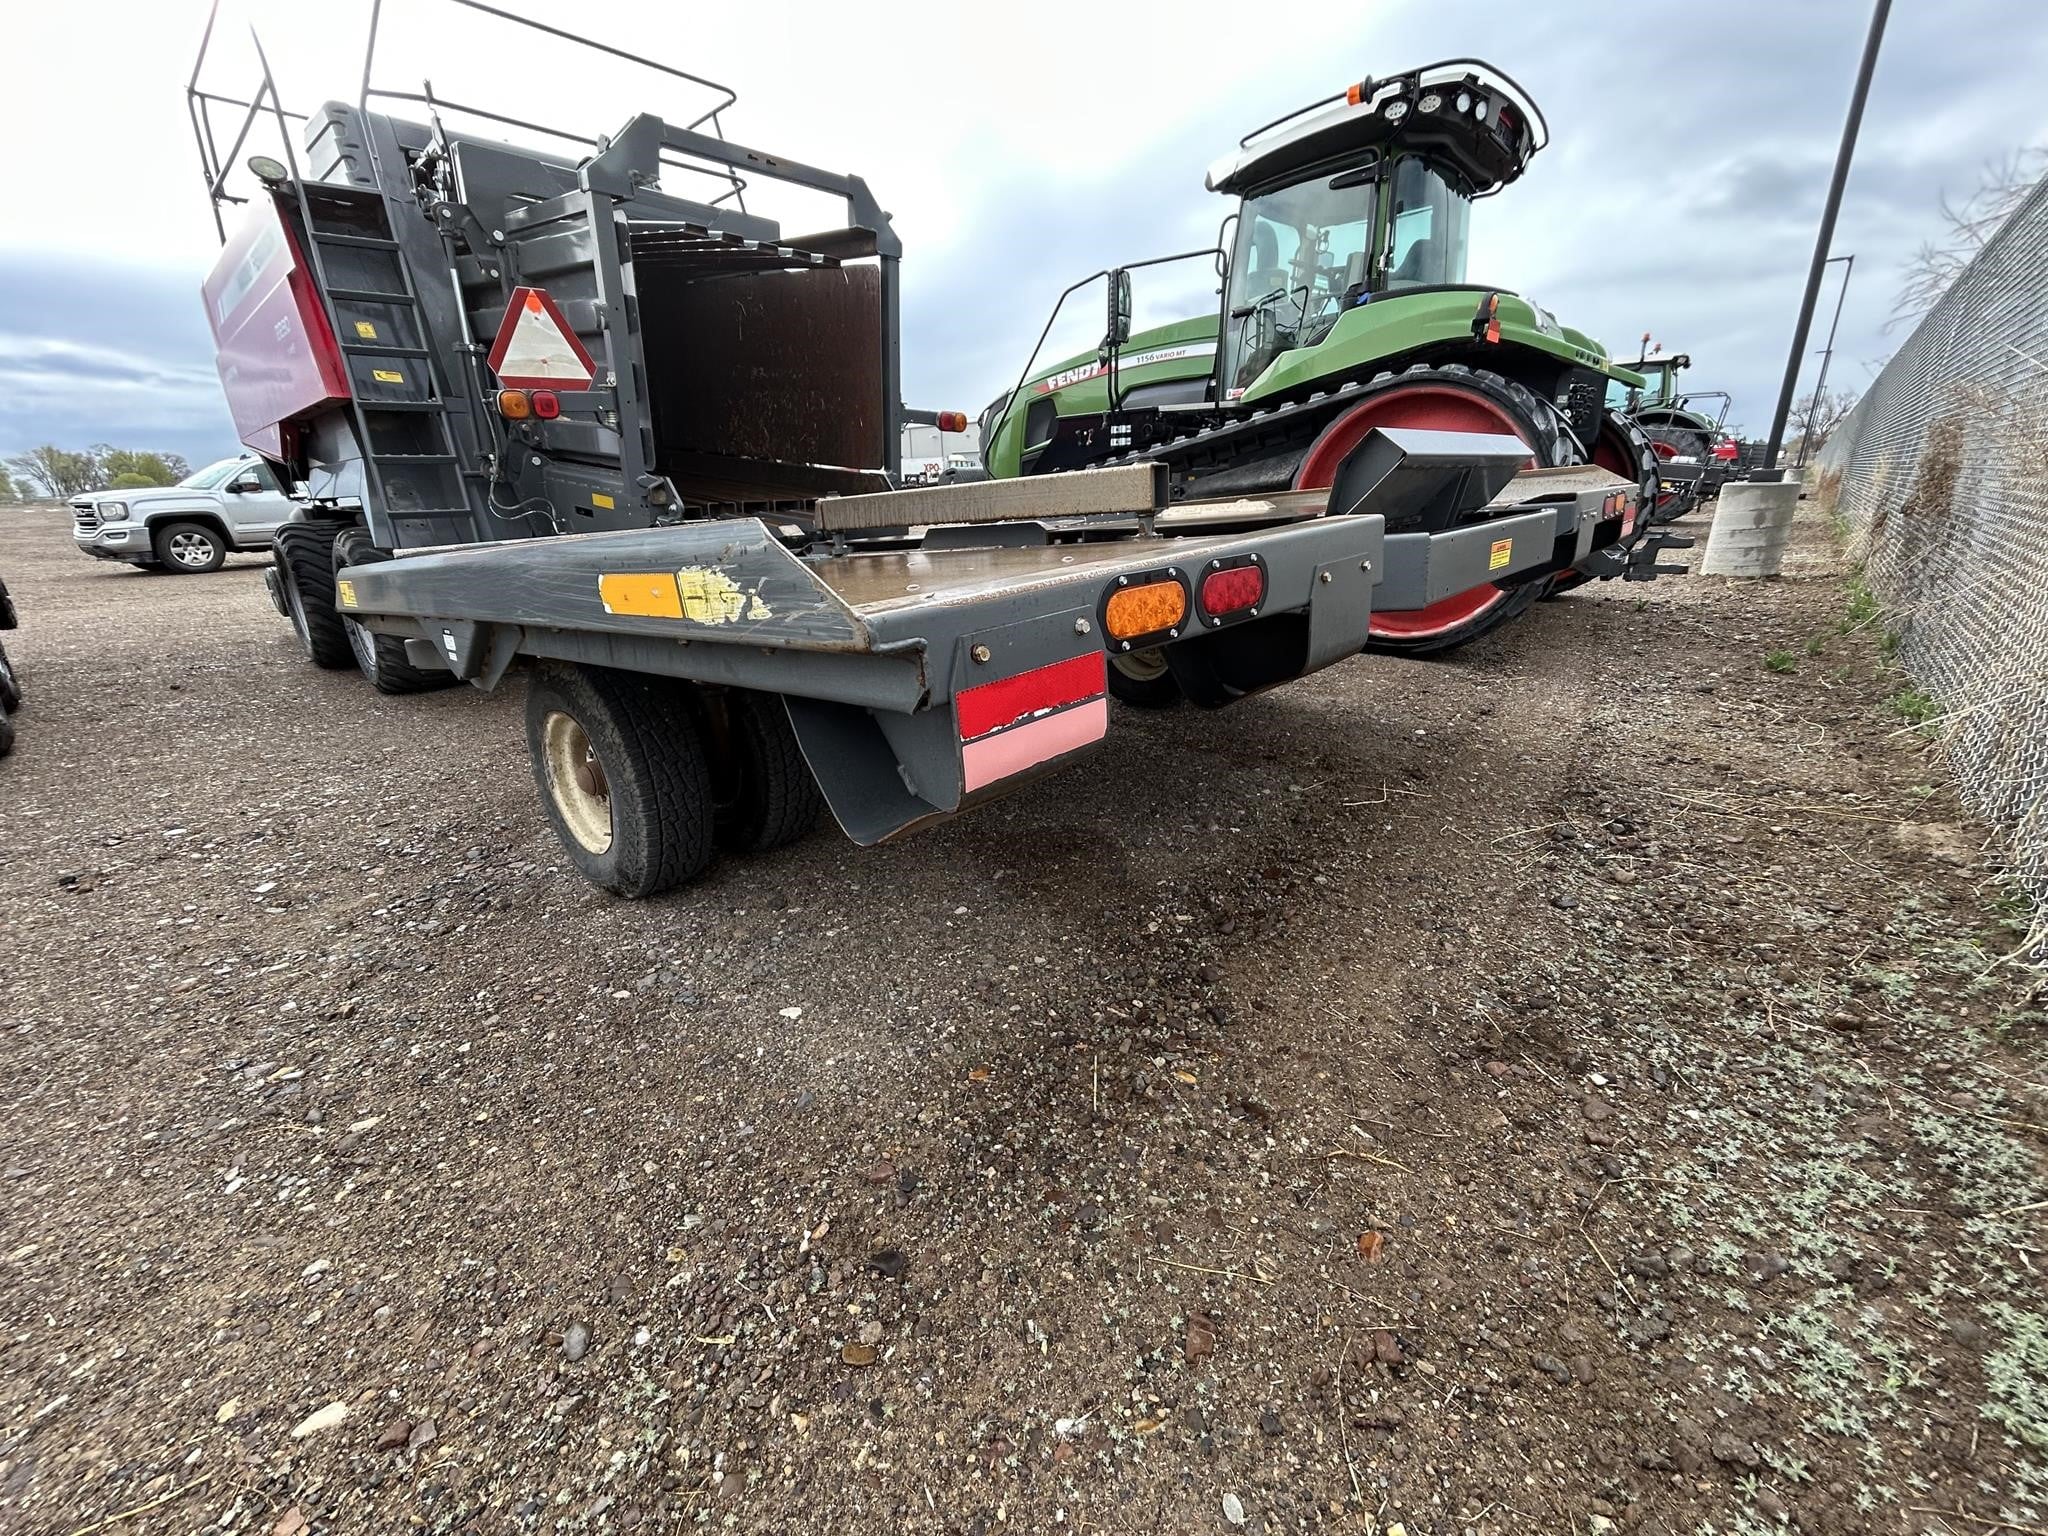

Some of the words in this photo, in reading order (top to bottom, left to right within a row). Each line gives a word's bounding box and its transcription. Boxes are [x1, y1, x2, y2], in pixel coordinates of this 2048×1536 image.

[1136, 353, 1154, 363] 1156
[1155, 351, 1175, 360] VARIO
[1047, 360, 1100, 390] FENDT
